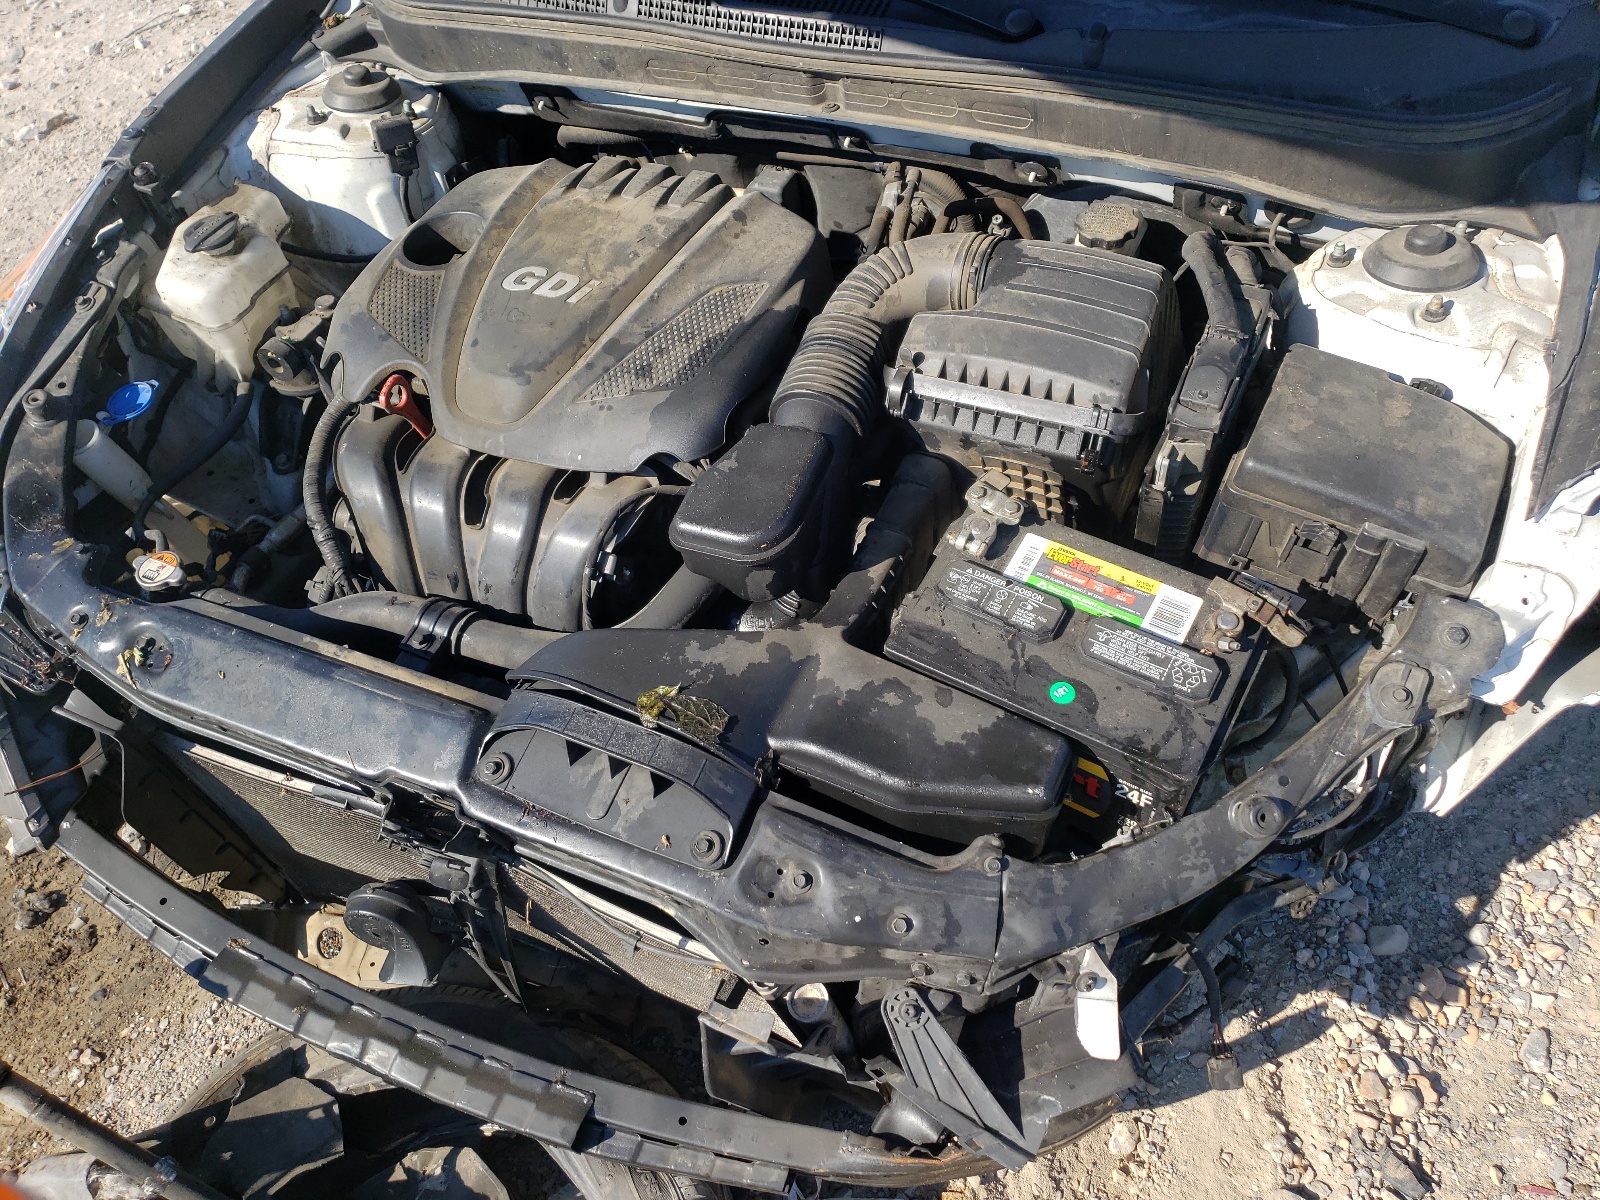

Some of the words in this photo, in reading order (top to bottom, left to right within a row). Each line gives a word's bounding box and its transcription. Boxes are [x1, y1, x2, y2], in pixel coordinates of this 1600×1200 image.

[1046, 548, 1100, 577] EverStart
[974, 570, 1007, 587] DANGER
[1013, 586, 1045, 602] POISON
[1115, 784, 1153, 807] 24F
